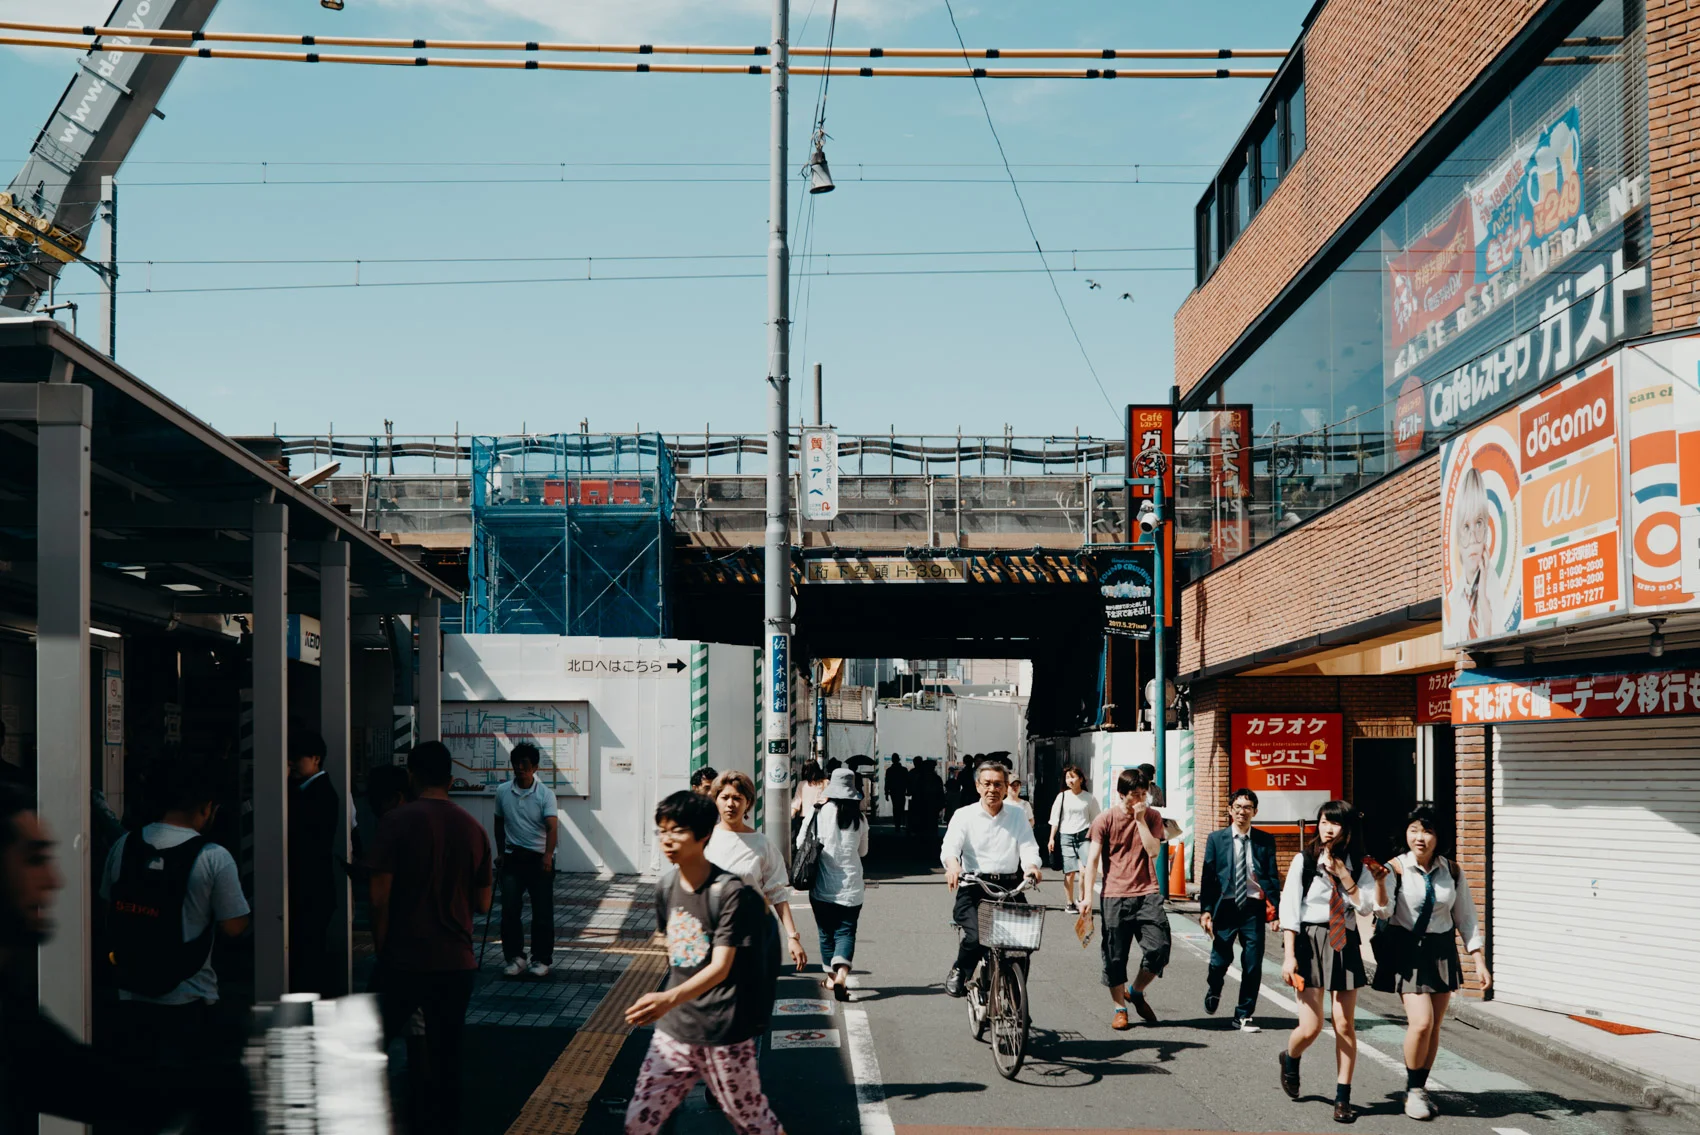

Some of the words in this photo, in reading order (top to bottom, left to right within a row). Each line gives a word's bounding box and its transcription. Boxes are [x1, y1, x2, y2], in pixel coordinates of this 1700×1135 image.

[1538, 249, 1647, 382] ガスト
[1140, 412, 1163, 422] Café
[1537, 412, 1550, 425] NTT
[1526, 397, 1607, 458] docomo
[1542, 473, 1590, 529] au
[567, 659, 662, 674] 北口へはこちら
[773, 637, 787, 711] 佐々木眼科
[1247, 718, 1327, 735] カラオケ
[1245, 749, 1327, 766] ビッグエコー
[1267, 774, 1291, 787] B1F
